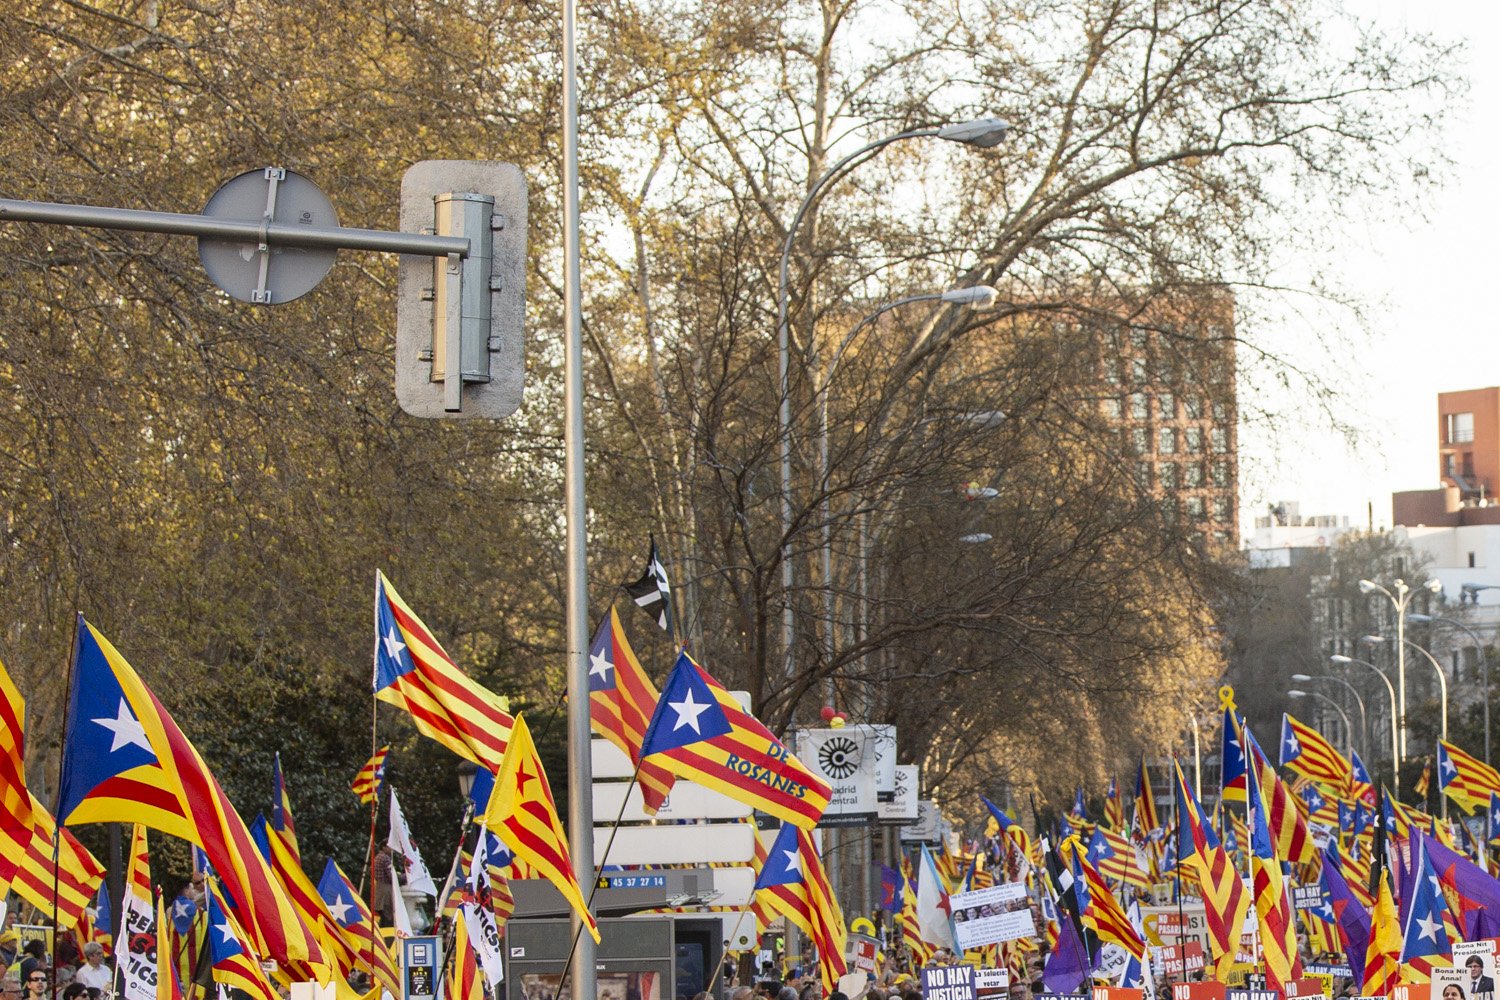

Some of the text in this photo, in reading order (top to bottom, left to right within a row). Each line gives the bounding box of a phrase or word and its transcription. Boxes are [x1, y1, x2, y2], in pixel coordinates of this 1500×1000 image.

[768, 741, 789, 764] DE
[726, 752, 808, 798] ROSANES
[613, 877, 663, 886] 45 37 27 14
[1295, 887, 1320, 898] NO HAY
[1163, 948, 1175, 960] NO
[1454, 948, 1490, 956] President!
[1166, 954, 1204, 975] PASARÁN
[927, 967, 970, 987] NO HAY
[1286, 982, 1297, 996] NO
